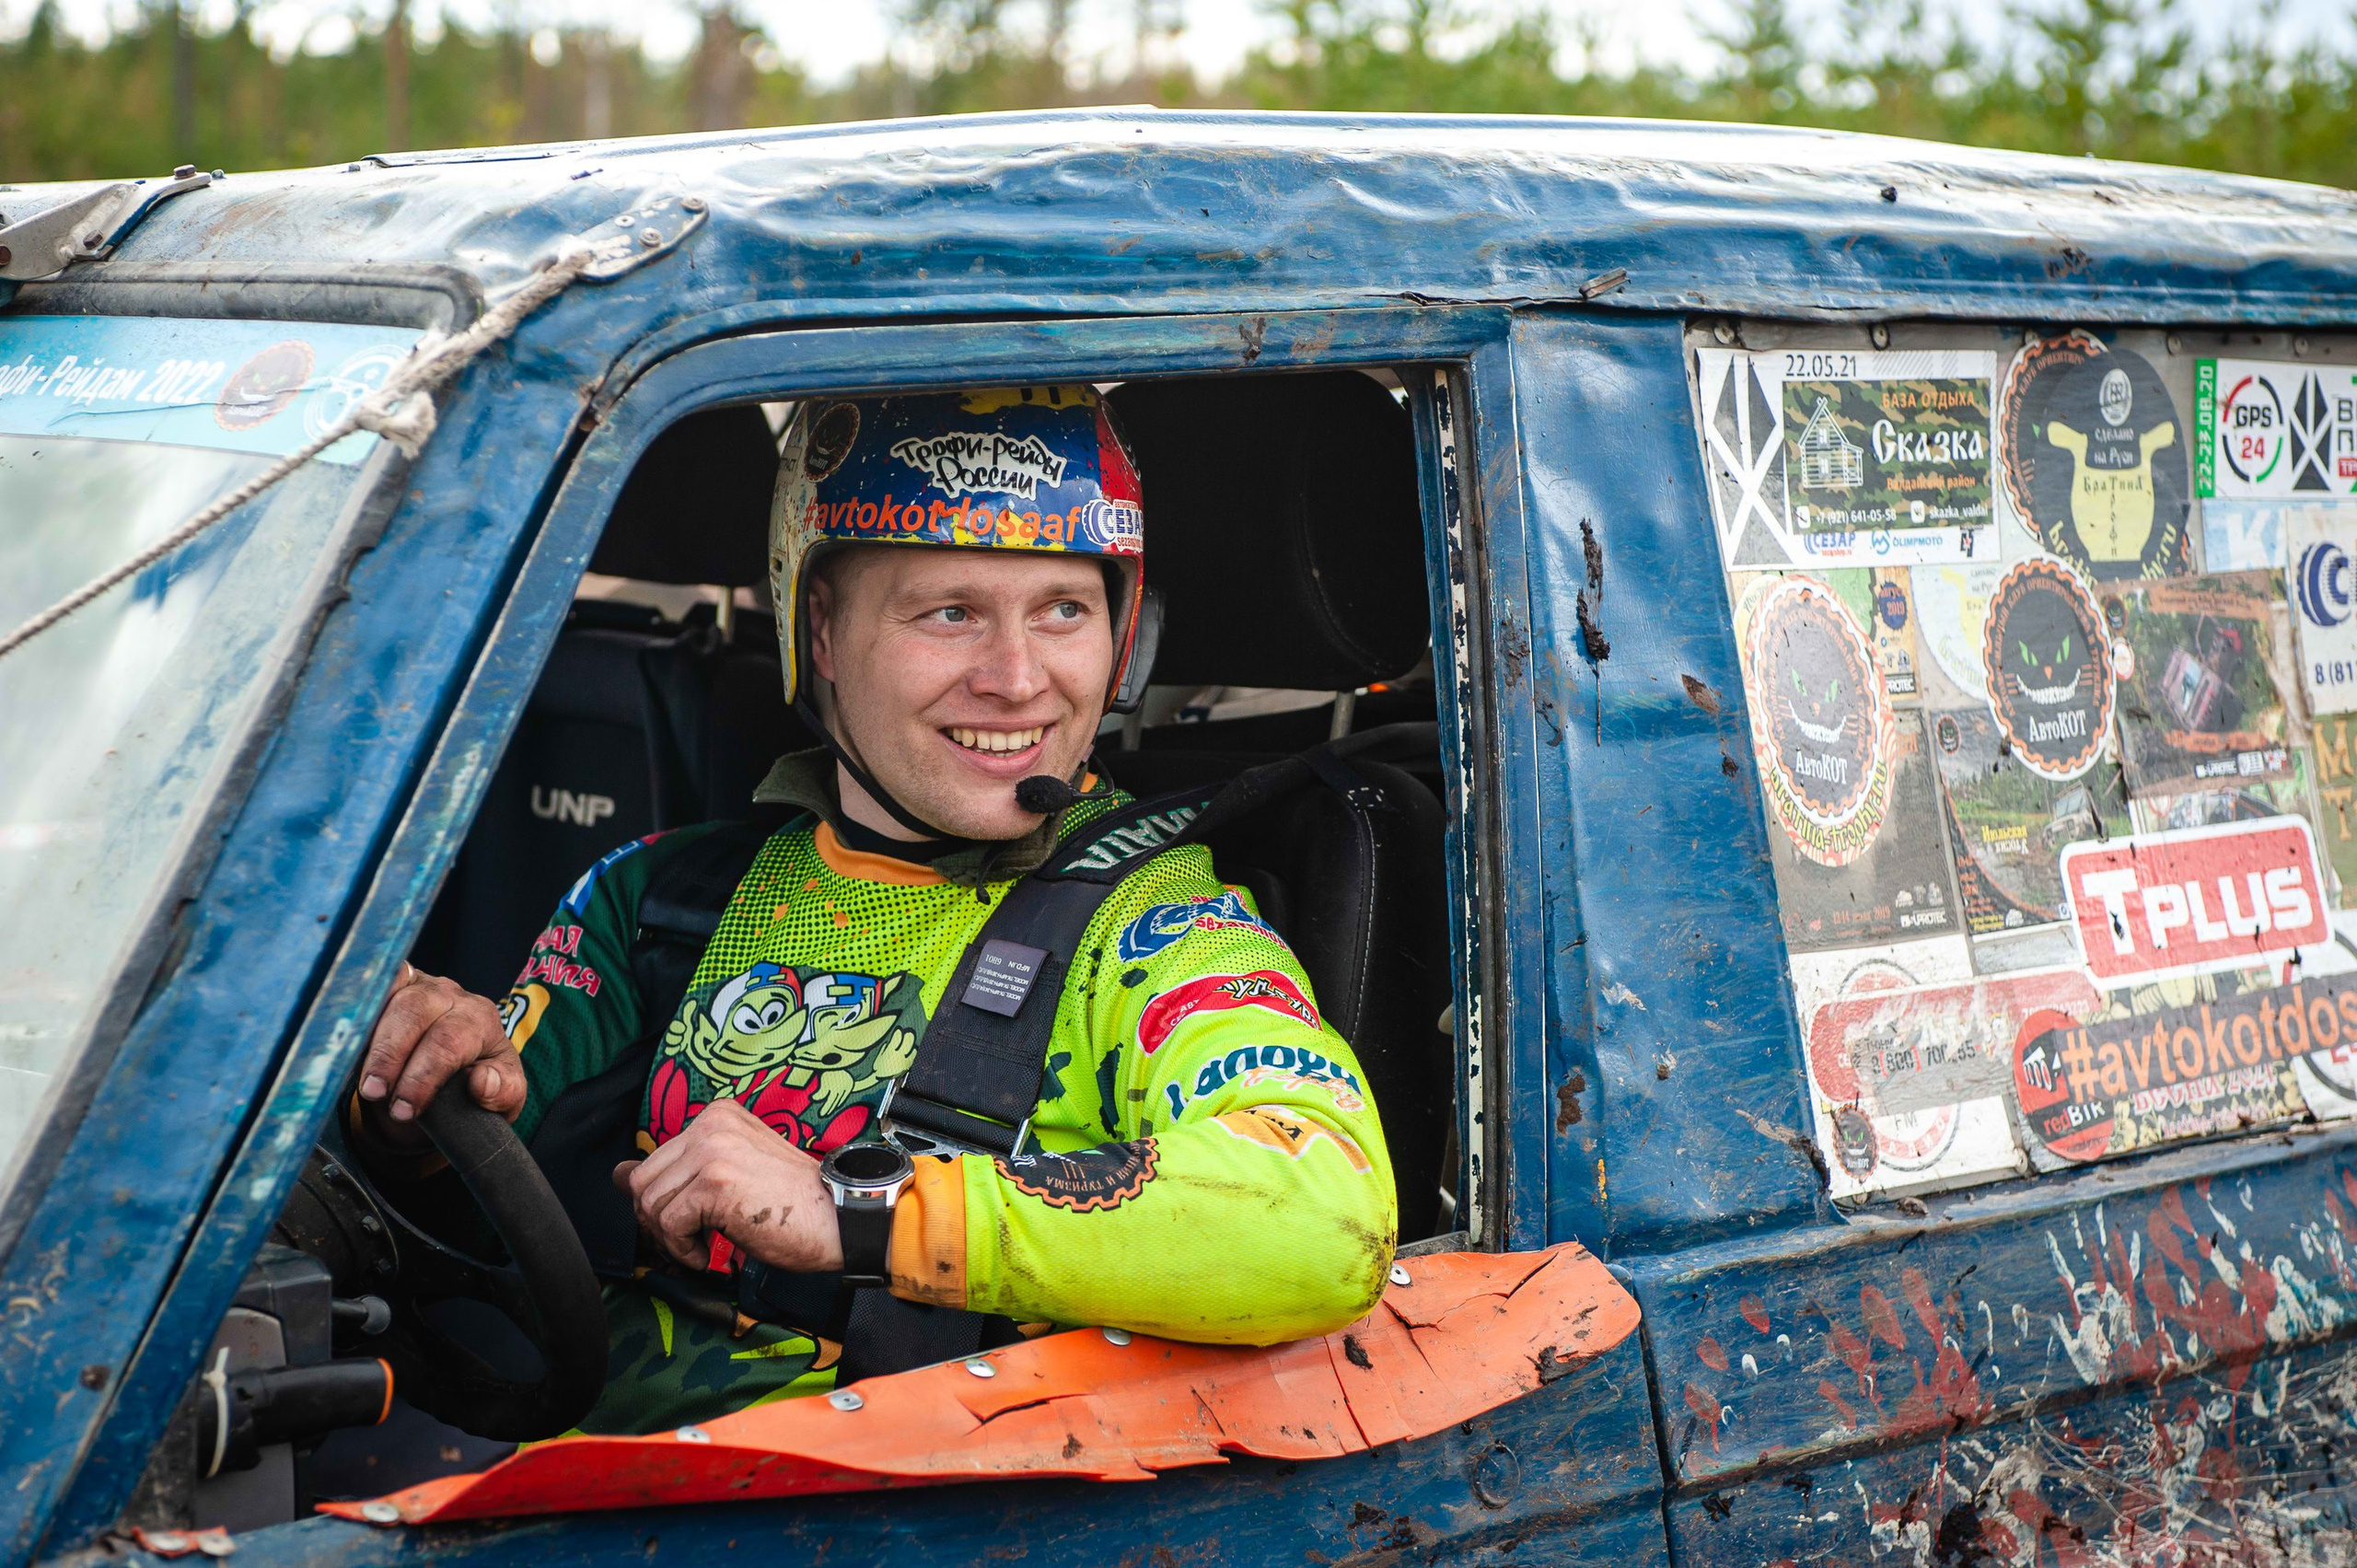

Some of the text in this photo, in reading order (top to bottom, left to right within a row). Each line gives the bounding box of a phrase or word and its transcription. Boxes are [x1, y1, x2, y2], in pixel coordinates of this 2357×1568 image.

[1785, 354, 1857, 377] 22.05.21
[135, 359, 226, 403] 2022
[1882, 389, 1976, 408] БАЗА ОТДЫХА
[2236, 405, 2272, 427] GPS
[1872, 419, 1984, 464] Сказка
[2241, 436, 2265, 459] 24
[1946, 474, 1976, 490] район
[1813, 531, 1856, 548] СЕЗАР
[1892, 535, 1944, 549] OLIMPMOTO
[2328, 660, 2357, 686] (81
[2028, 709, 2086, 743] АвтоКОТ
[1795, 751, 1848, 785] АвтоКОТ
[530, 784, 615, 828] UNP
[1044, 1175, 1105, 1192] ТУРИЗМА
